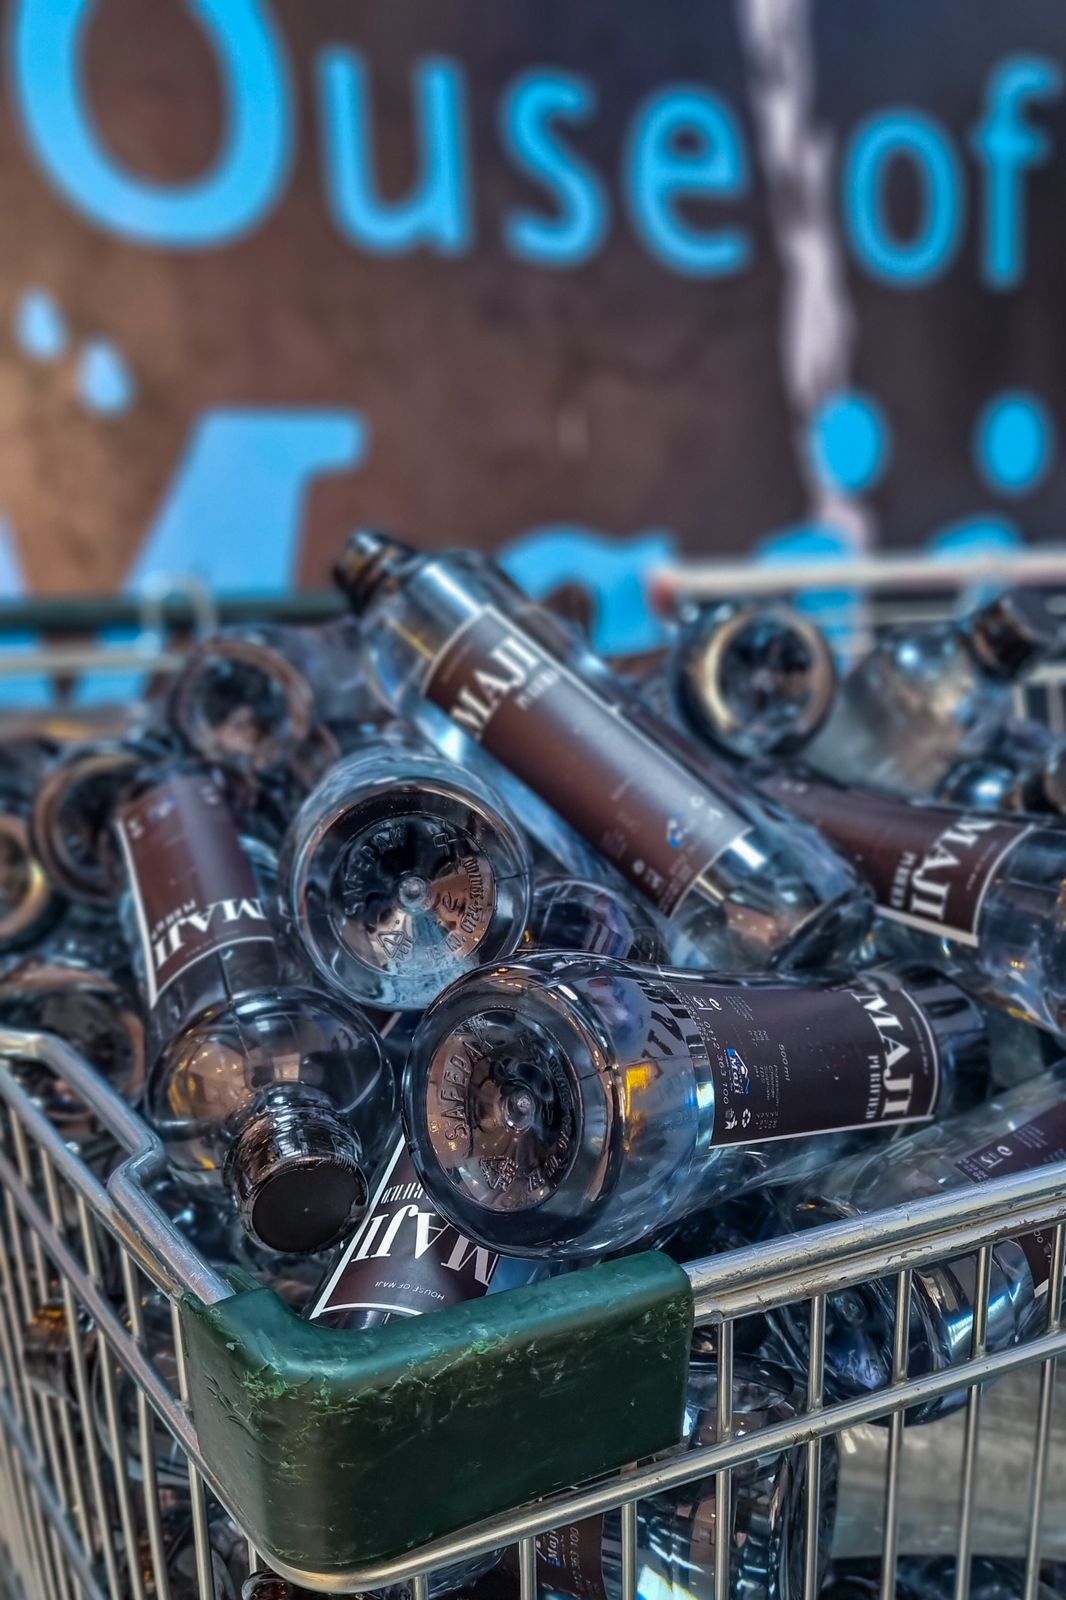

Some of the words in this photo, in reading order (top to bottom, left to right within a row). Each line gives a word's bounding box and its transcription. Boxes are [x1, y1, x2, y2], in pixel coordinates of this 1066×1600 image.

[843, 54, 1063, 289] of
[911, 815, 996, 920] MAJI
[155, 899, 267, 971] MAJI
[851, 993, 914, 1118] MAJI
[380, 1182, 430, 1204] RIFIED
[351, 1204, 500, 1287] MAJI
[374, 1279, 398, 1289] MAJI
[398, 1282, 412, 1291] OF
[414, 1285, 446, 1300] HOUSE
